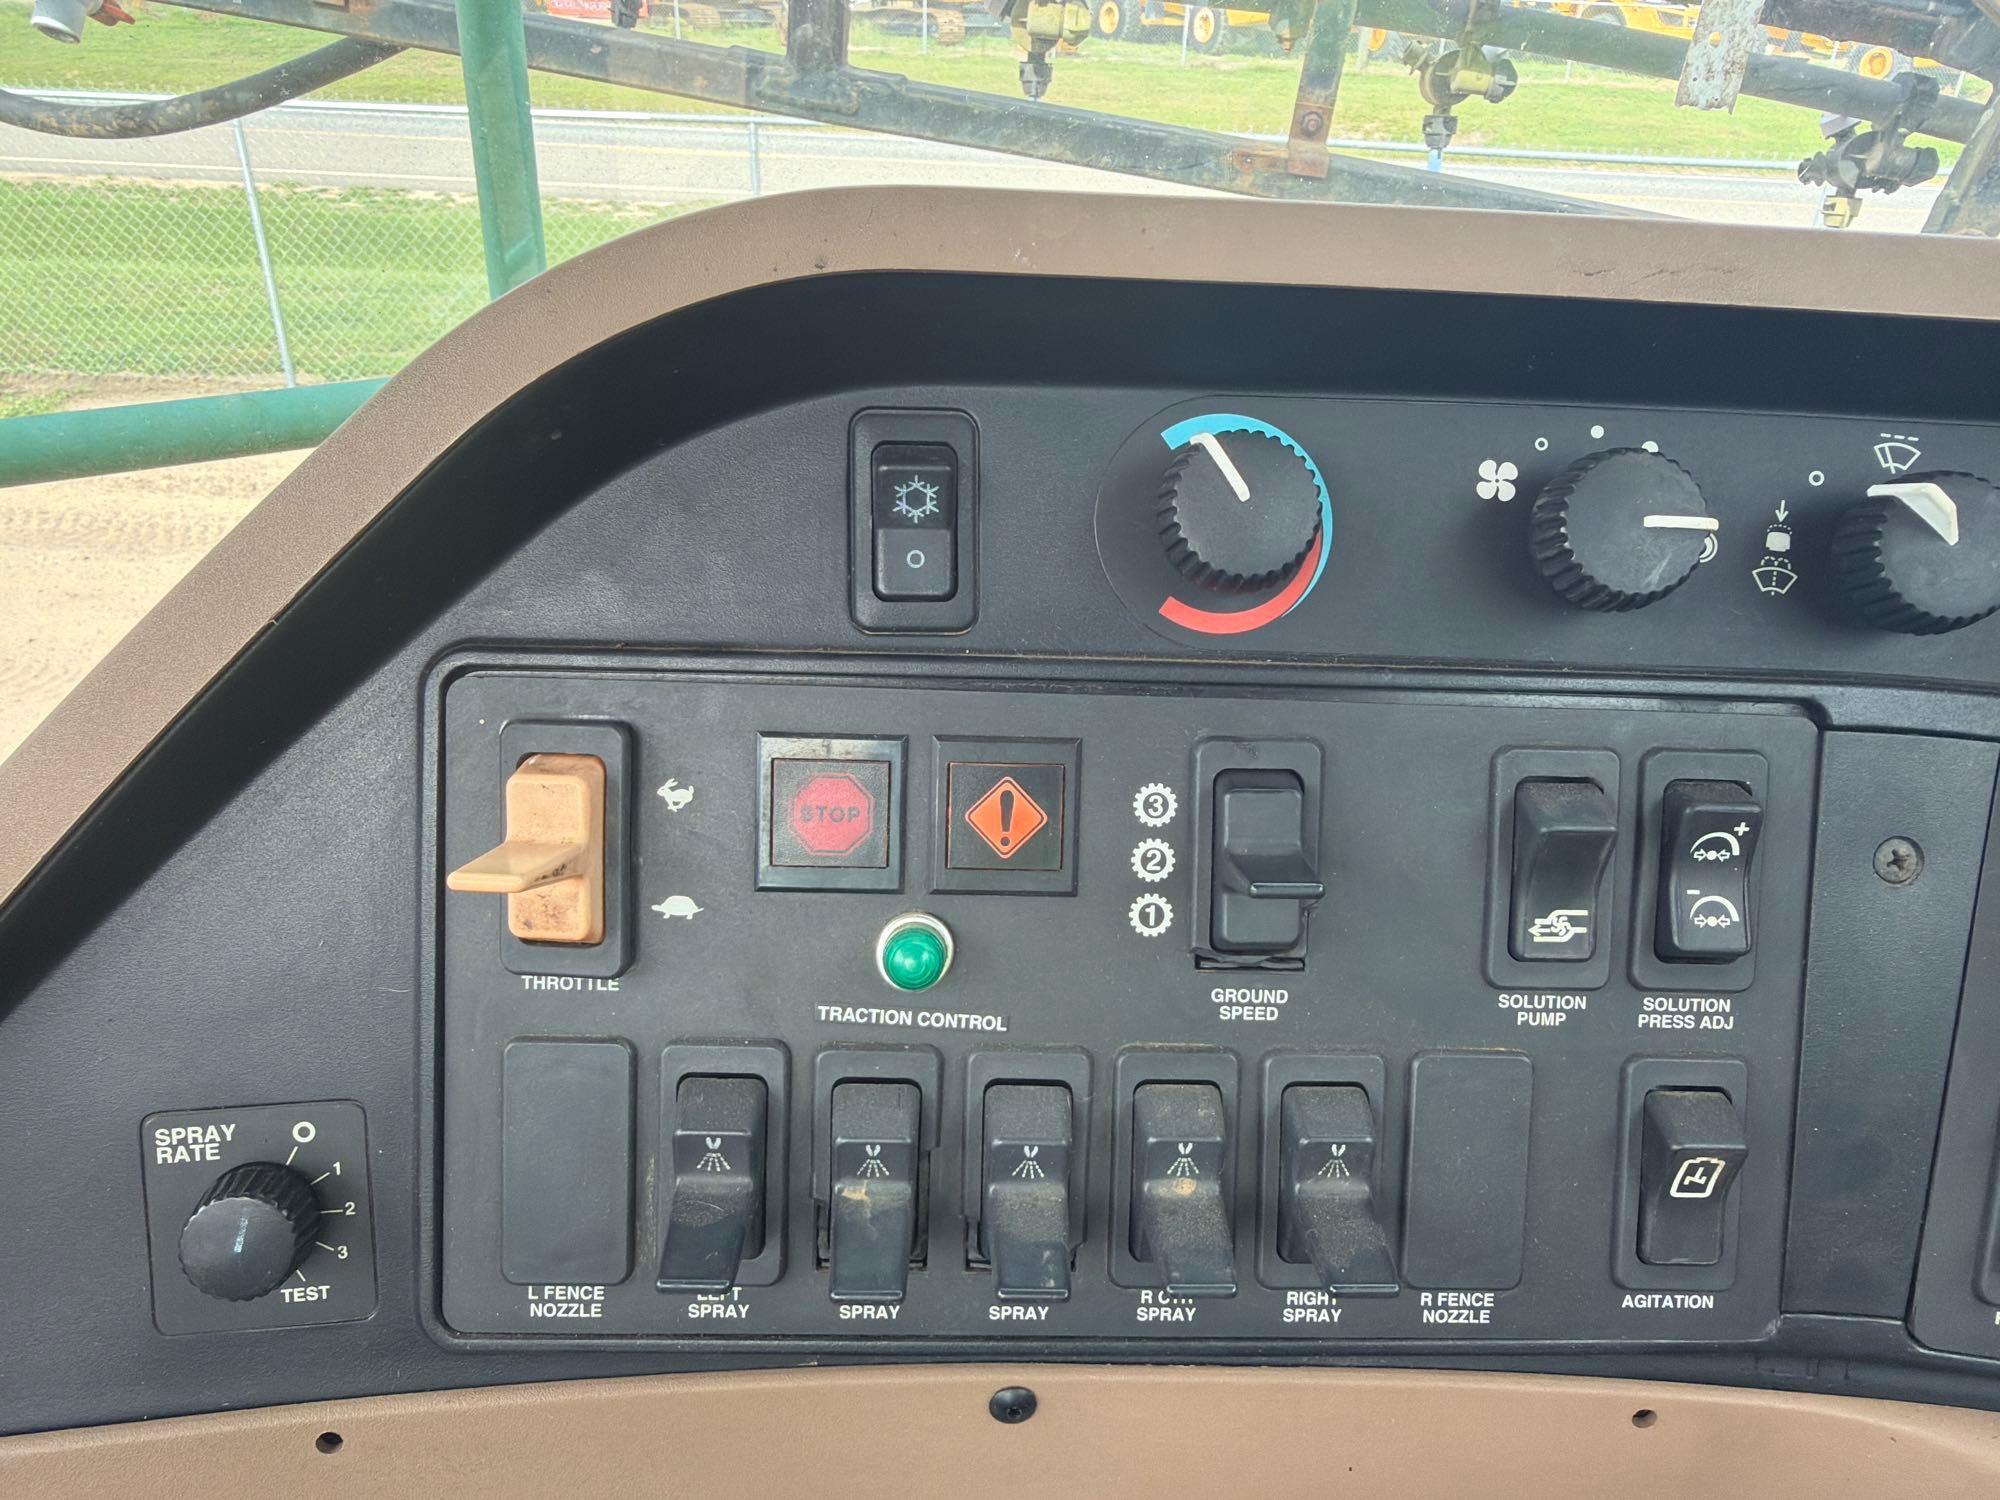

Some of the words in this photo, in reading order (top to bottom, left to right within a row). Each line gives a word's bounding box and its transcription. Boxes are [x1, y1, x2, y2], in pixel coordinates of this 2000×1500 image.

[799, 804, 861, 823] STOP
[1148, 795, 1164, 817] 3
[1146, 849, 1162, 871] 2
[1145, 905, 1156, 926] 1
[521, 975, 620, 991] THROTTLE
[1211, 988, 1289, 1004] GROUND
[1498, 994, 1587, 1010] SOLUTION
[1643, 997, 1731, 1013] SOLUTION
[817, 1005, 912, 1026] TRACTION
[917, 1011, 1008, 1031] CONTROL
[1219, 1006, 1279, 1021] SPEED
[1517, 1011, 1567, 1026] PUMP
[1637, 1014, 1695, 1029] PRESS
[1699, 1015, 1734, 1030] ADJ
[154, 1123, 236, 1147] SPRAY
[156, 1143, 221, 1165] RATE
[333, 1161, 341, 1175] 1
[345, 1201, 356, 1215] 2
[337, 1245, 348, 1259] 3
[280, 1285, 331, 1303] TEST
[528, 1285, 539, 1300] L
[544, 1285, 605, 1300] FENCE
[1140, 1289, 1153, 1304] R
[1420, 1292, 1433, 1307] R
[1437, 1292, 1495, 1307] FENCE
[1621, 1294, 1714, 1310] AGITATION
[530, 1303, 602, 1318] NOZZLE
[688, 1303, 750, 1318] SPRAY
[839, 1304, 901, 1319] SPRAY
[988, 1306, 1049, 1320] SPRAY
[1136, 1306, 1197, 1322] SPRAY
[1282, 1308, 1342, 1323] SPRAY
[1422, 1309, 1491, 1324] NOZZLE
